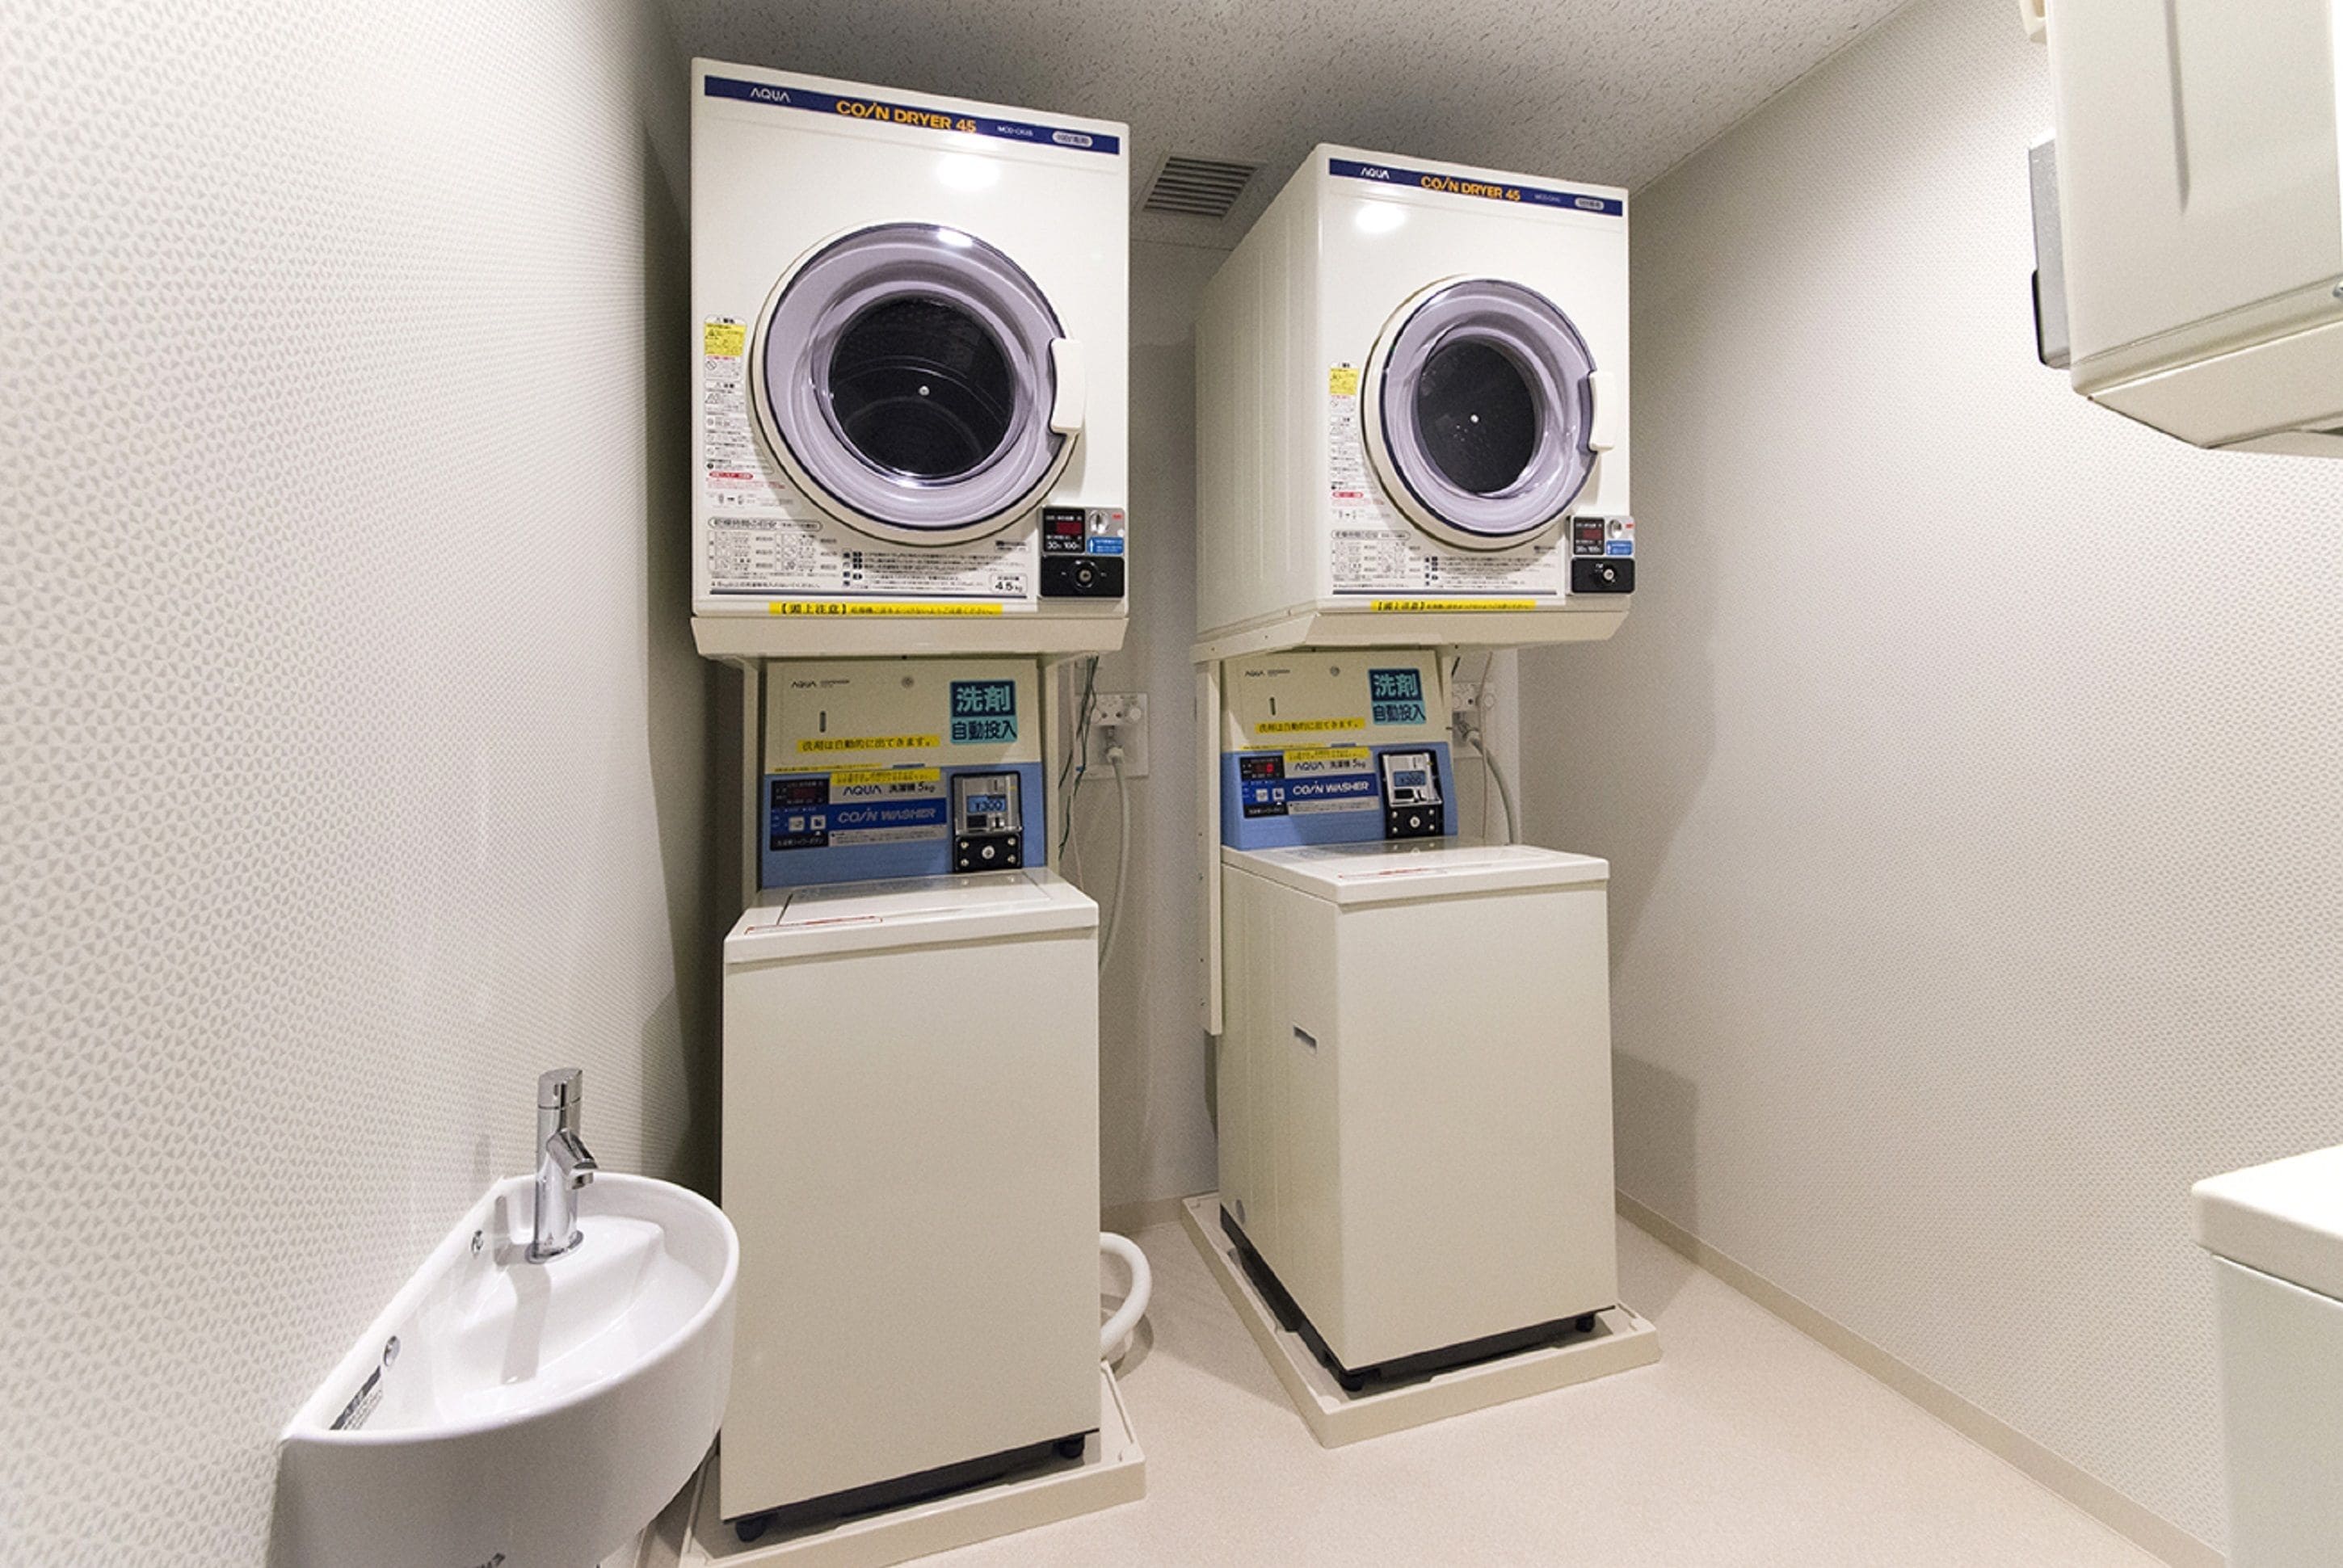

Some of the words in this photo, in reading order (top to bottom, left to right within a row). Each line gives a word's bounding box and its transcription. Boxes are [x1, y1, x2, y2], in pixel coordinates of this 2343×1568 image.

[751, 87, 790, 103] AQUA
[894, 109, 952, 130] DRYER
[956, 120, 977, 132] 45
[1361, 166, 1390, 179] AQUA
[1461, 183, 1503, 200] DRYER
[1505, 190, 1521, 202] 45
[1373, 672, 1419, 697] 洗剤
[956, 685, 1011, 713] 洗剤
[1373, 704, 1426, 722] 自動投入
[951, 720, 1018, 741] 自動投入
[1294, 761, 1325, 771] AQUA
[843, 784, 882, 796] AQUA
[1325, 780, 1370, 793] WASHER
[881, 808, 937, 821] WASHER
